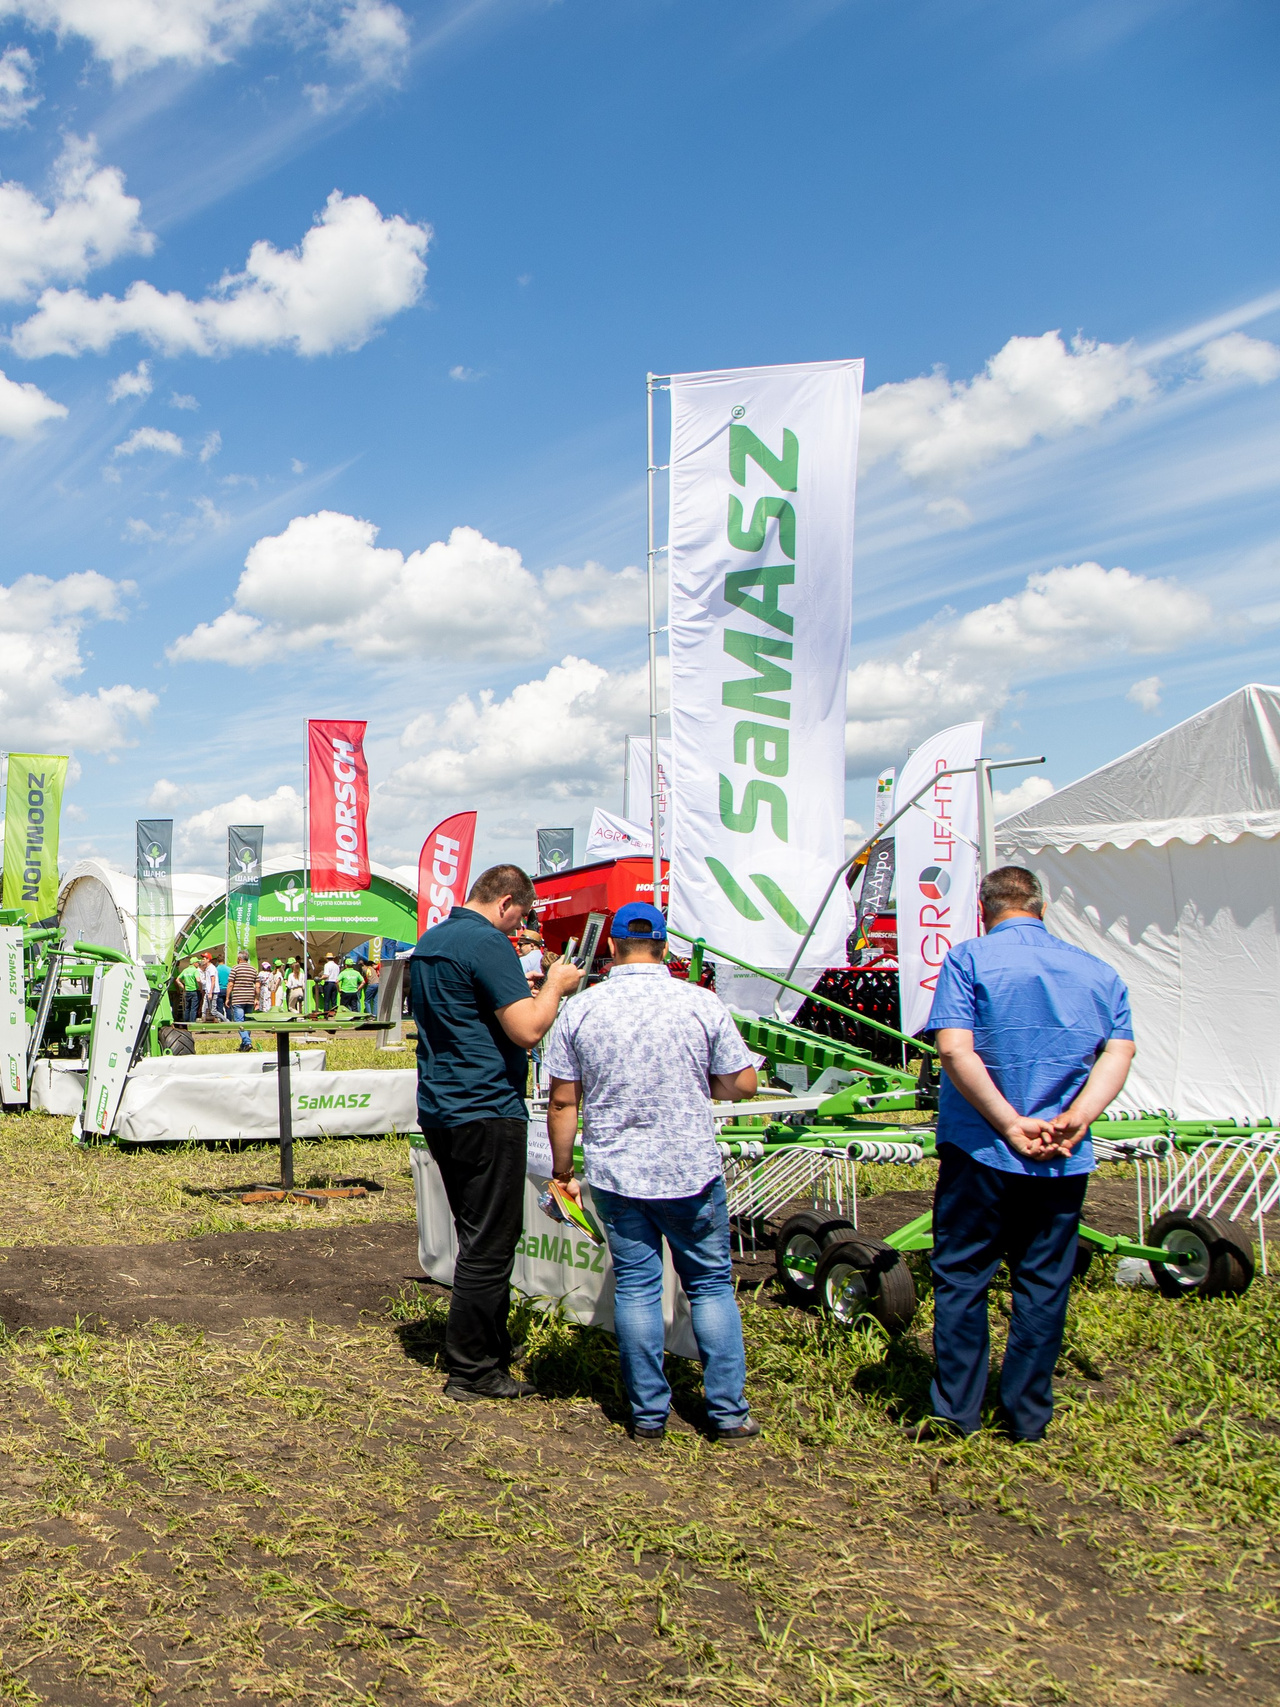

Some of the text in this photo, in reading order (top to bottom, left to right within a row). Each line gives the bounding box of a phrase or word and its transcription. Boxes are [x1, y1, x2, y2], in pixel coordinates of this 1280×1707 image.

[719, 423, 800, 843] SaMASZ
[332, 738, 359, 877] HORSCH
[21, 772, 45, 902] ZOOMLION
[631, 839, 654, 849] ЦЕНТ
[143, 870, 167, 878] ШАНС
[234, 874, 259, 883] ШАНС
[635, 883, 670, 892] HORCH
[8, 953, 17, 995] SaMASZ
[115, 980, 133, 1033] SaMASZ
[297, 1093, 371, 1110] SaMASZ
[515, 1233, 605, 1273] SaMASZ
